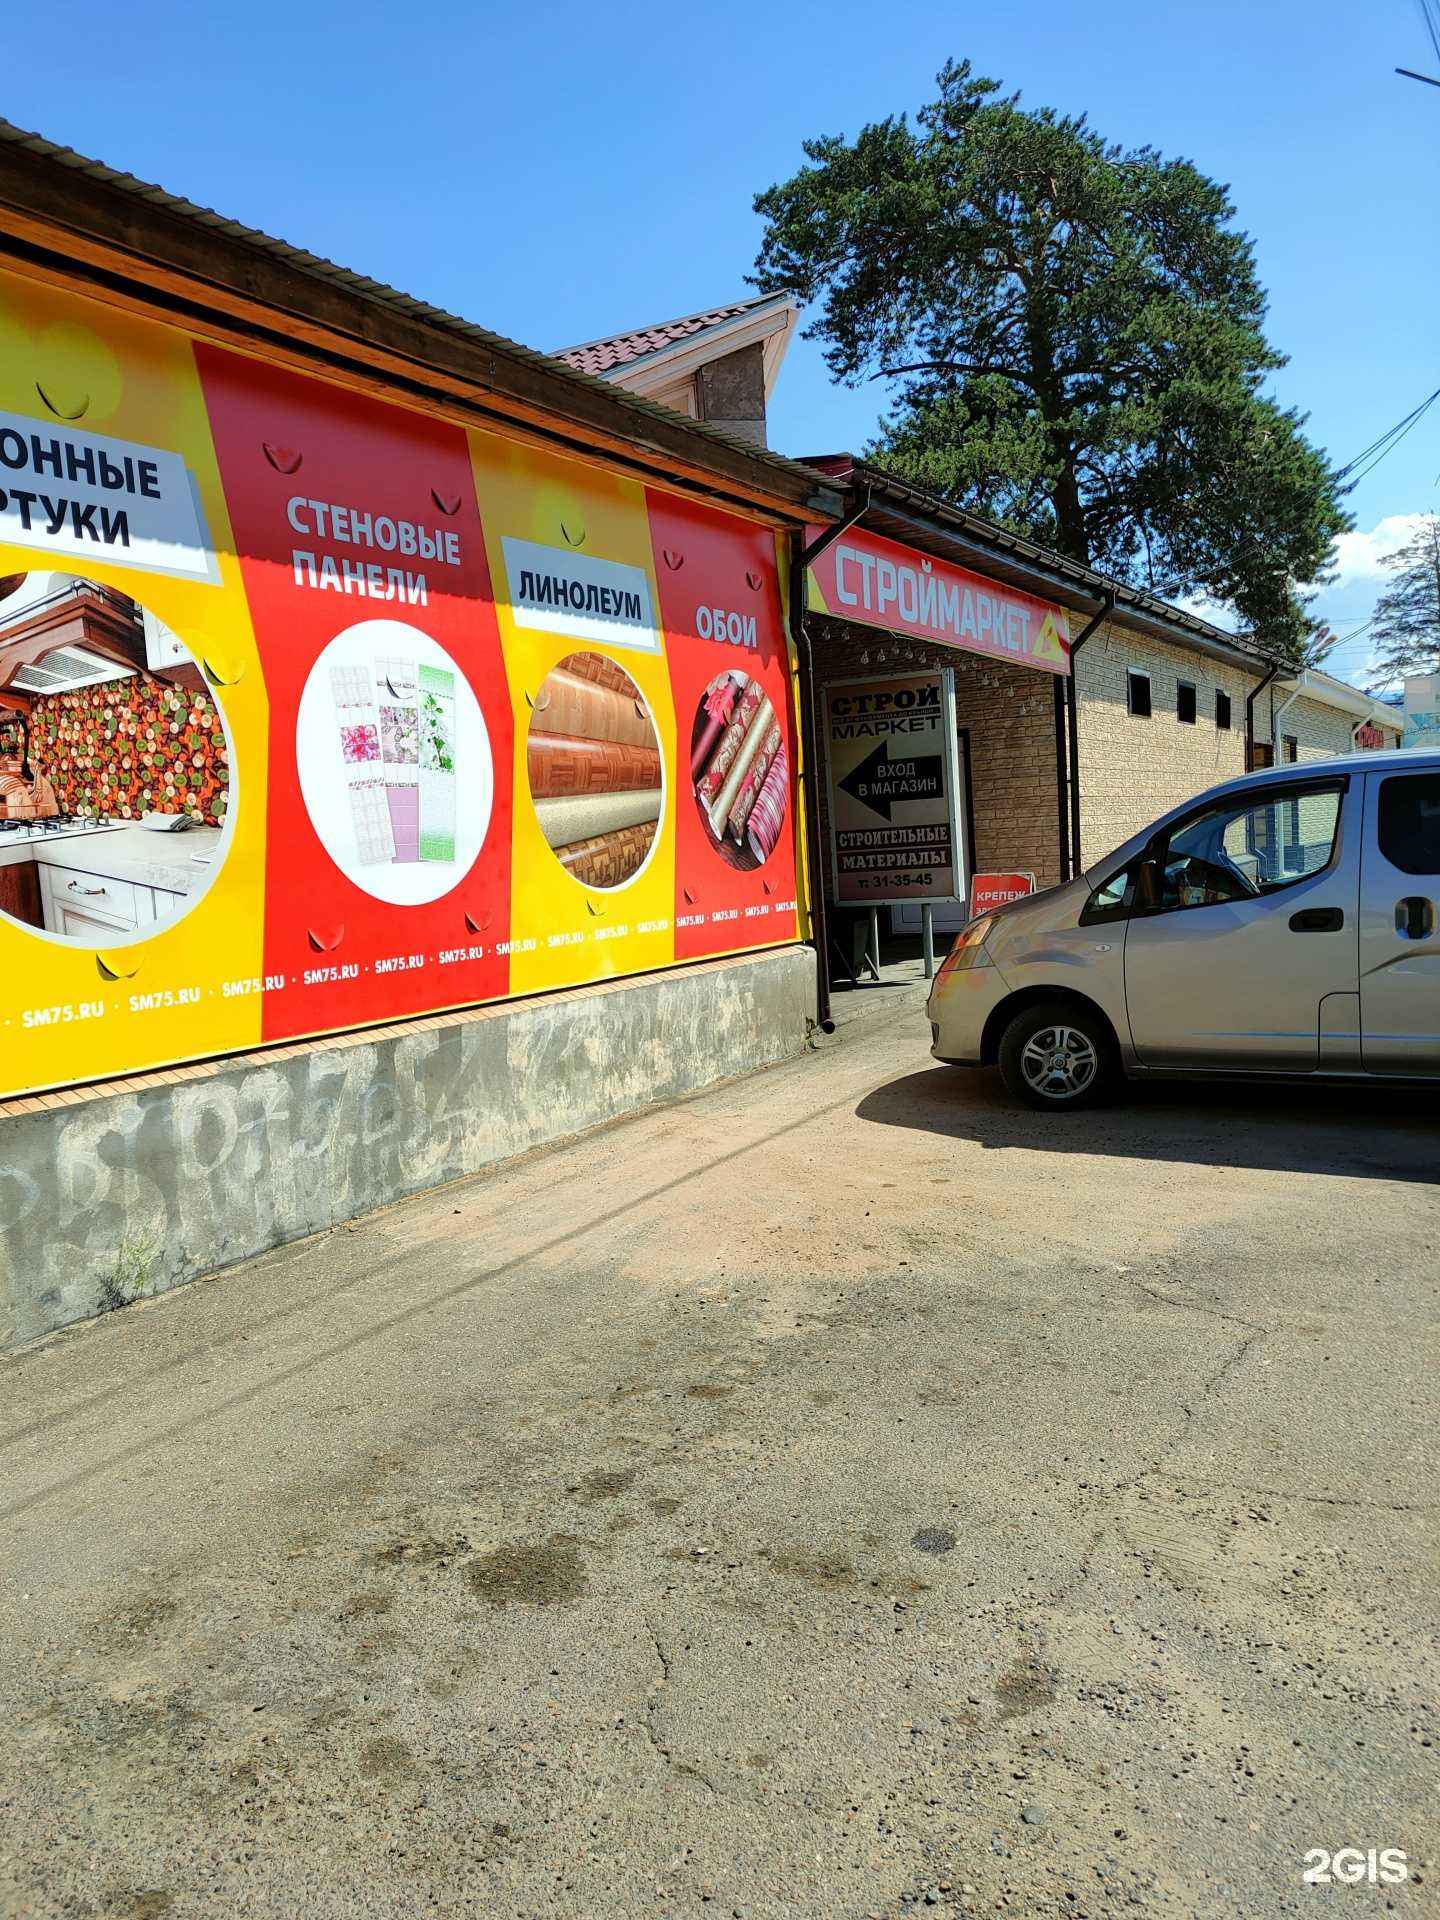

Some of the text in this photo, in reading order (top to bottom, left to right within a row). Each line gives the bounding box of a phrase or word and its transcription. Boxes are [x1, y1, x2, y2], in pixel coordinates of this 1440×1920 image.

[287, 496, 462, 566] СТЕНОВЫЕ
[292, 550, 428, 607] ПАНЕЛИ
[519, 571, 642, 621] ЛИНОЛЕУМ
[835, 544, 1031, 655] СТРОЙМАРКЕТ
[695, 606, 757, 648] ОБОИ
[831, 683, 940, 716] СТРОЙ
[832, 714, 941, 740] МАРКЕТ
[877, 762, 916, 778] ВХОД
[858, 777, 937, 796] В МАГАЗИН
[839, 825, 948, 848] СТРОИТЕЛЬНЫЕ
[842, 850, 946, 869] МАТЕРИАЛЫ
[872, 873, 933, 888] 31-35-45
[976, 890, 1026, 902] КРЕПЕЖ
[22, 1002, 105, 1028] SM75.RU
[129, 987, 201, 1012] SM75.RU
[222, 975, 285, 997] SM75.RU
[303, 964, 359, 985] SM75.RU
[375, 955, 424, 974] SM75.RU
[438, 947, 483, 964] SM75.RU
[496, 939, 536, 955] SM75.RU
[547, 931, 584, 948] SM75.RU
[595, 925, 628, 940] SM75.RU
[637, 919, 669, 933] SM75.RU
[676, 914, 705, 928] SM75.RU
[712, 909, 738, 922] SM75.RU
[745, 905, 769, 917] SM75.RU
